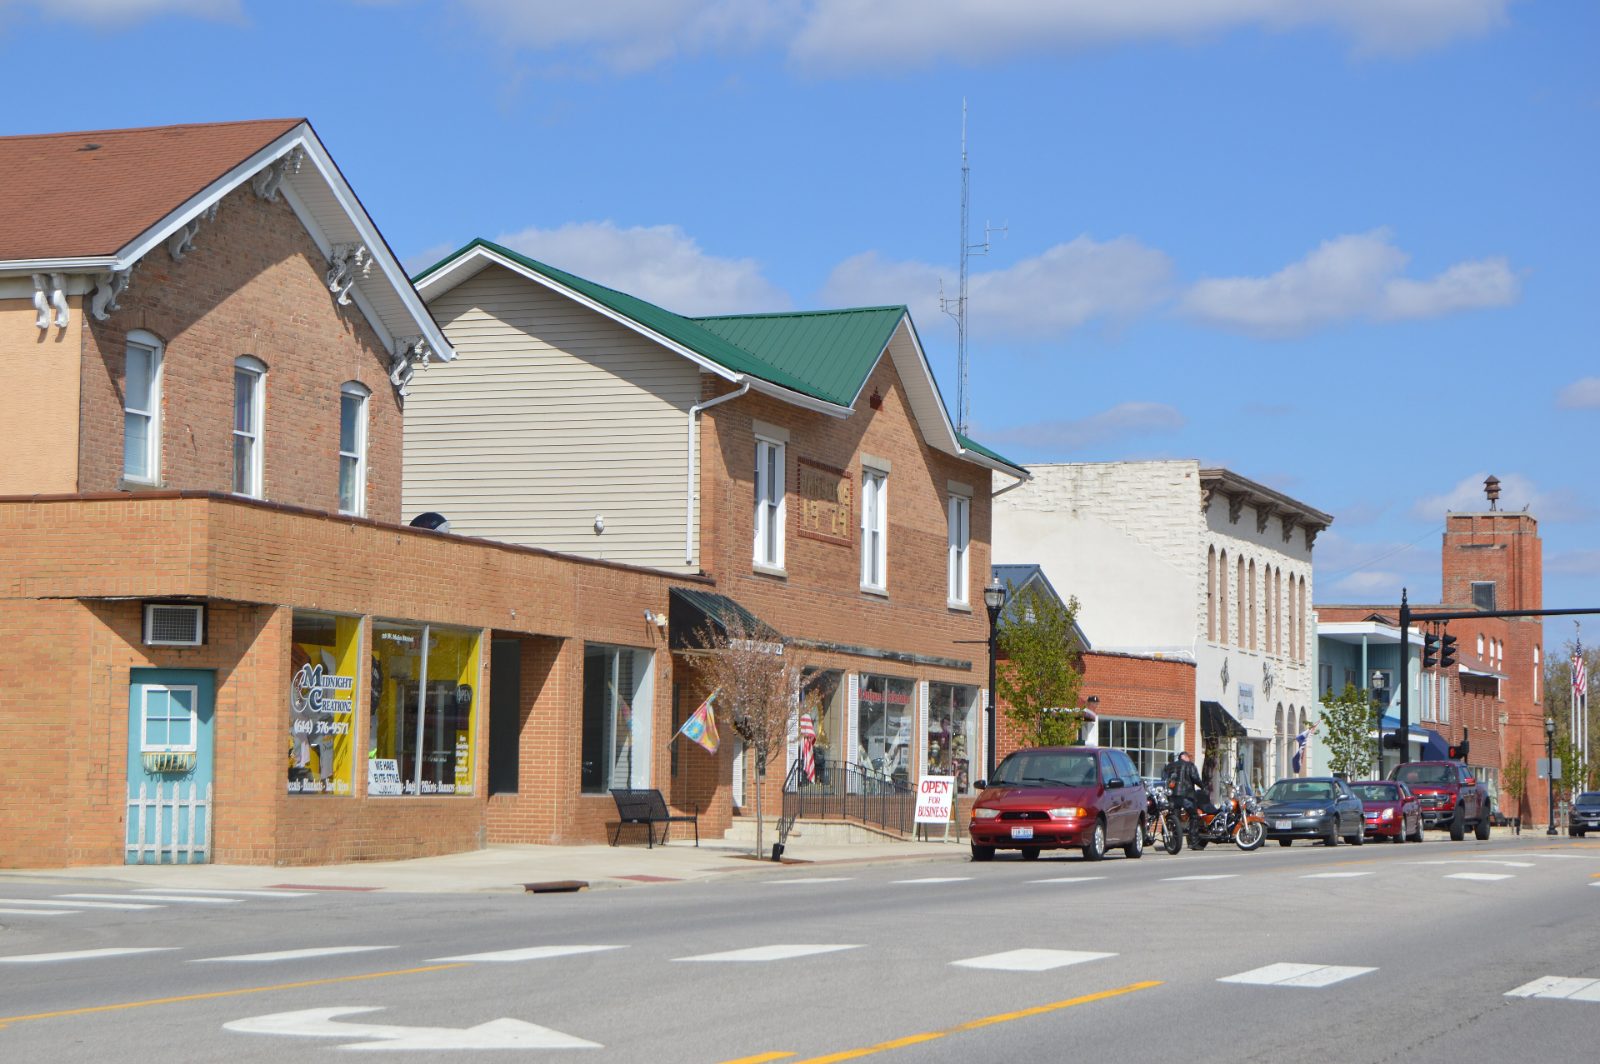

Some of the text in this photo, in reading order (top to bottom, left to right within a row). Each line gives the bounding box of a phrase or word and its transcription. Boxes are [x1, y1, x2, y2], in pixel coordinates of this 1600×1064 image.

[294, 718, 349, 735] (614) 376-9571
[921, 780, 949, 795] OPEN
[928, 796, 941, 804] FOR
[918, 806, 948, 818] BUSINESS
